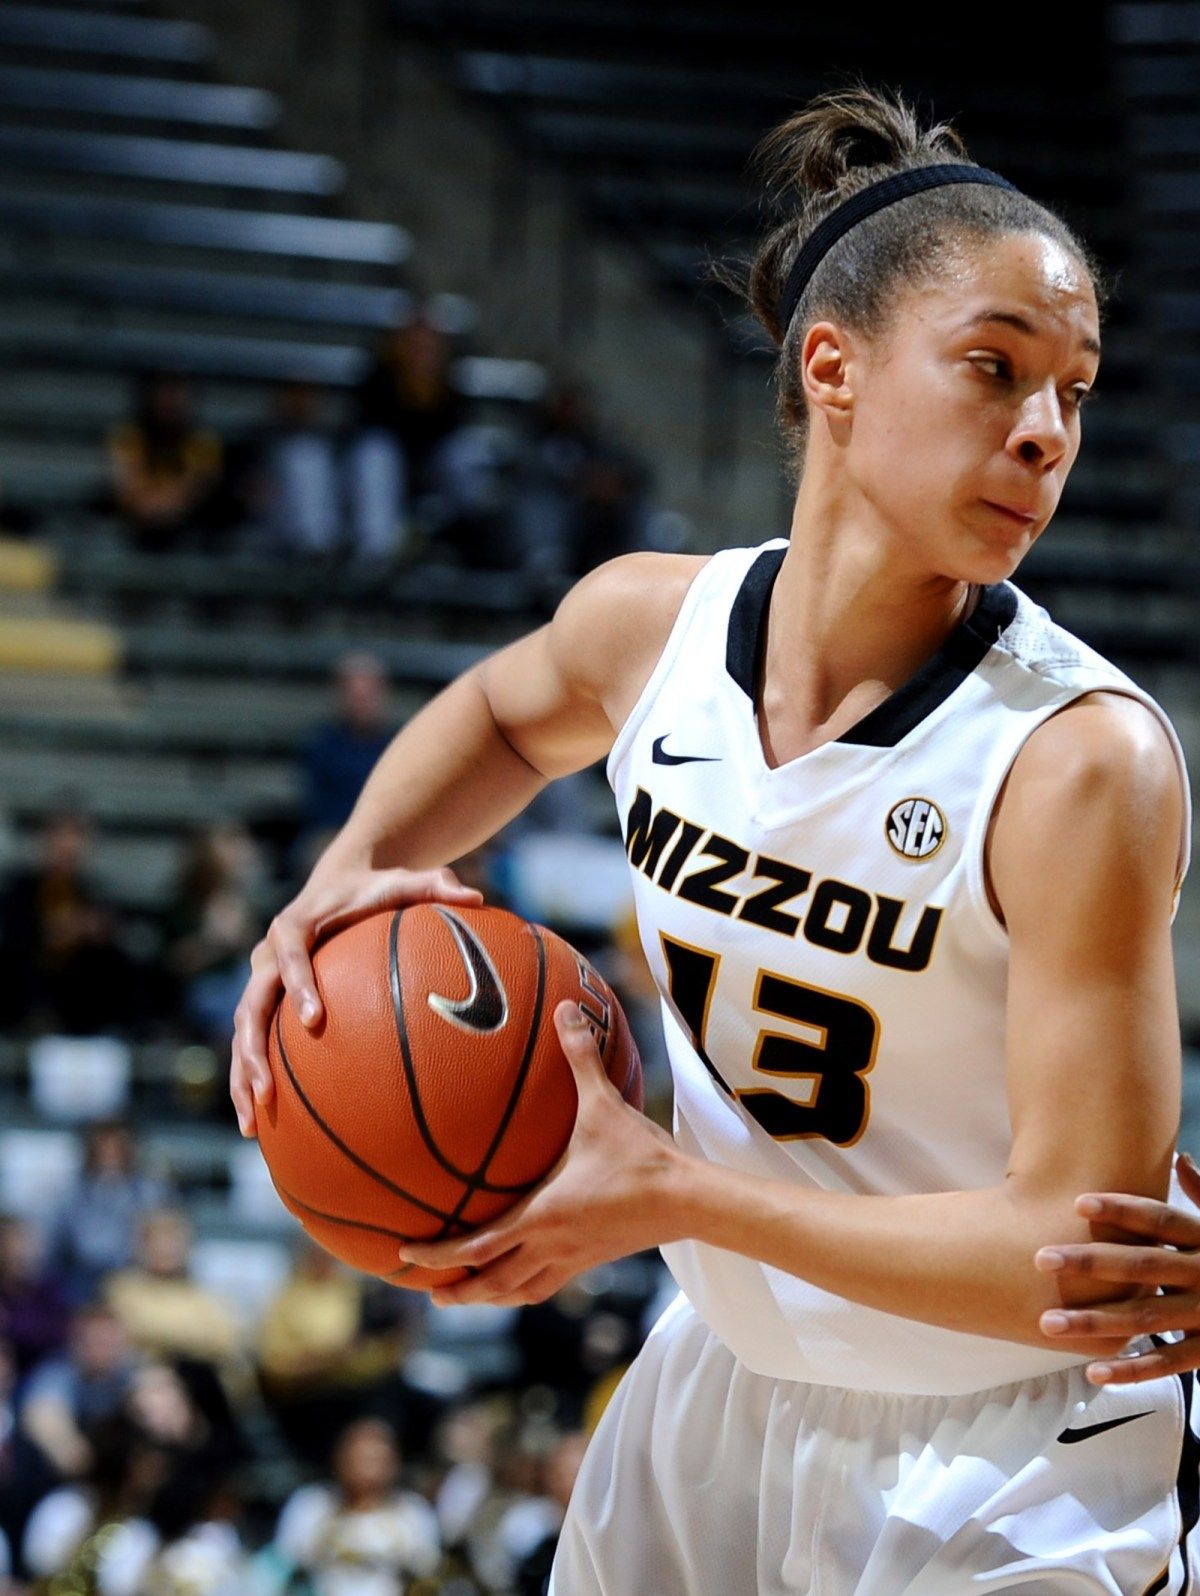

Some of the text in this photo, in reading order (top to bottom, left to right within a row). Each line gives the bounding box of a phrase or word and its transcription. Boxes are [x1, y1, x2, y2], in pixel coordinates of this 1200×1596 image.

[626, 786, 945, 973] MIZZOU
[888, 799, 943, 857] SEC
[658, 930, 882, 1149] 13
